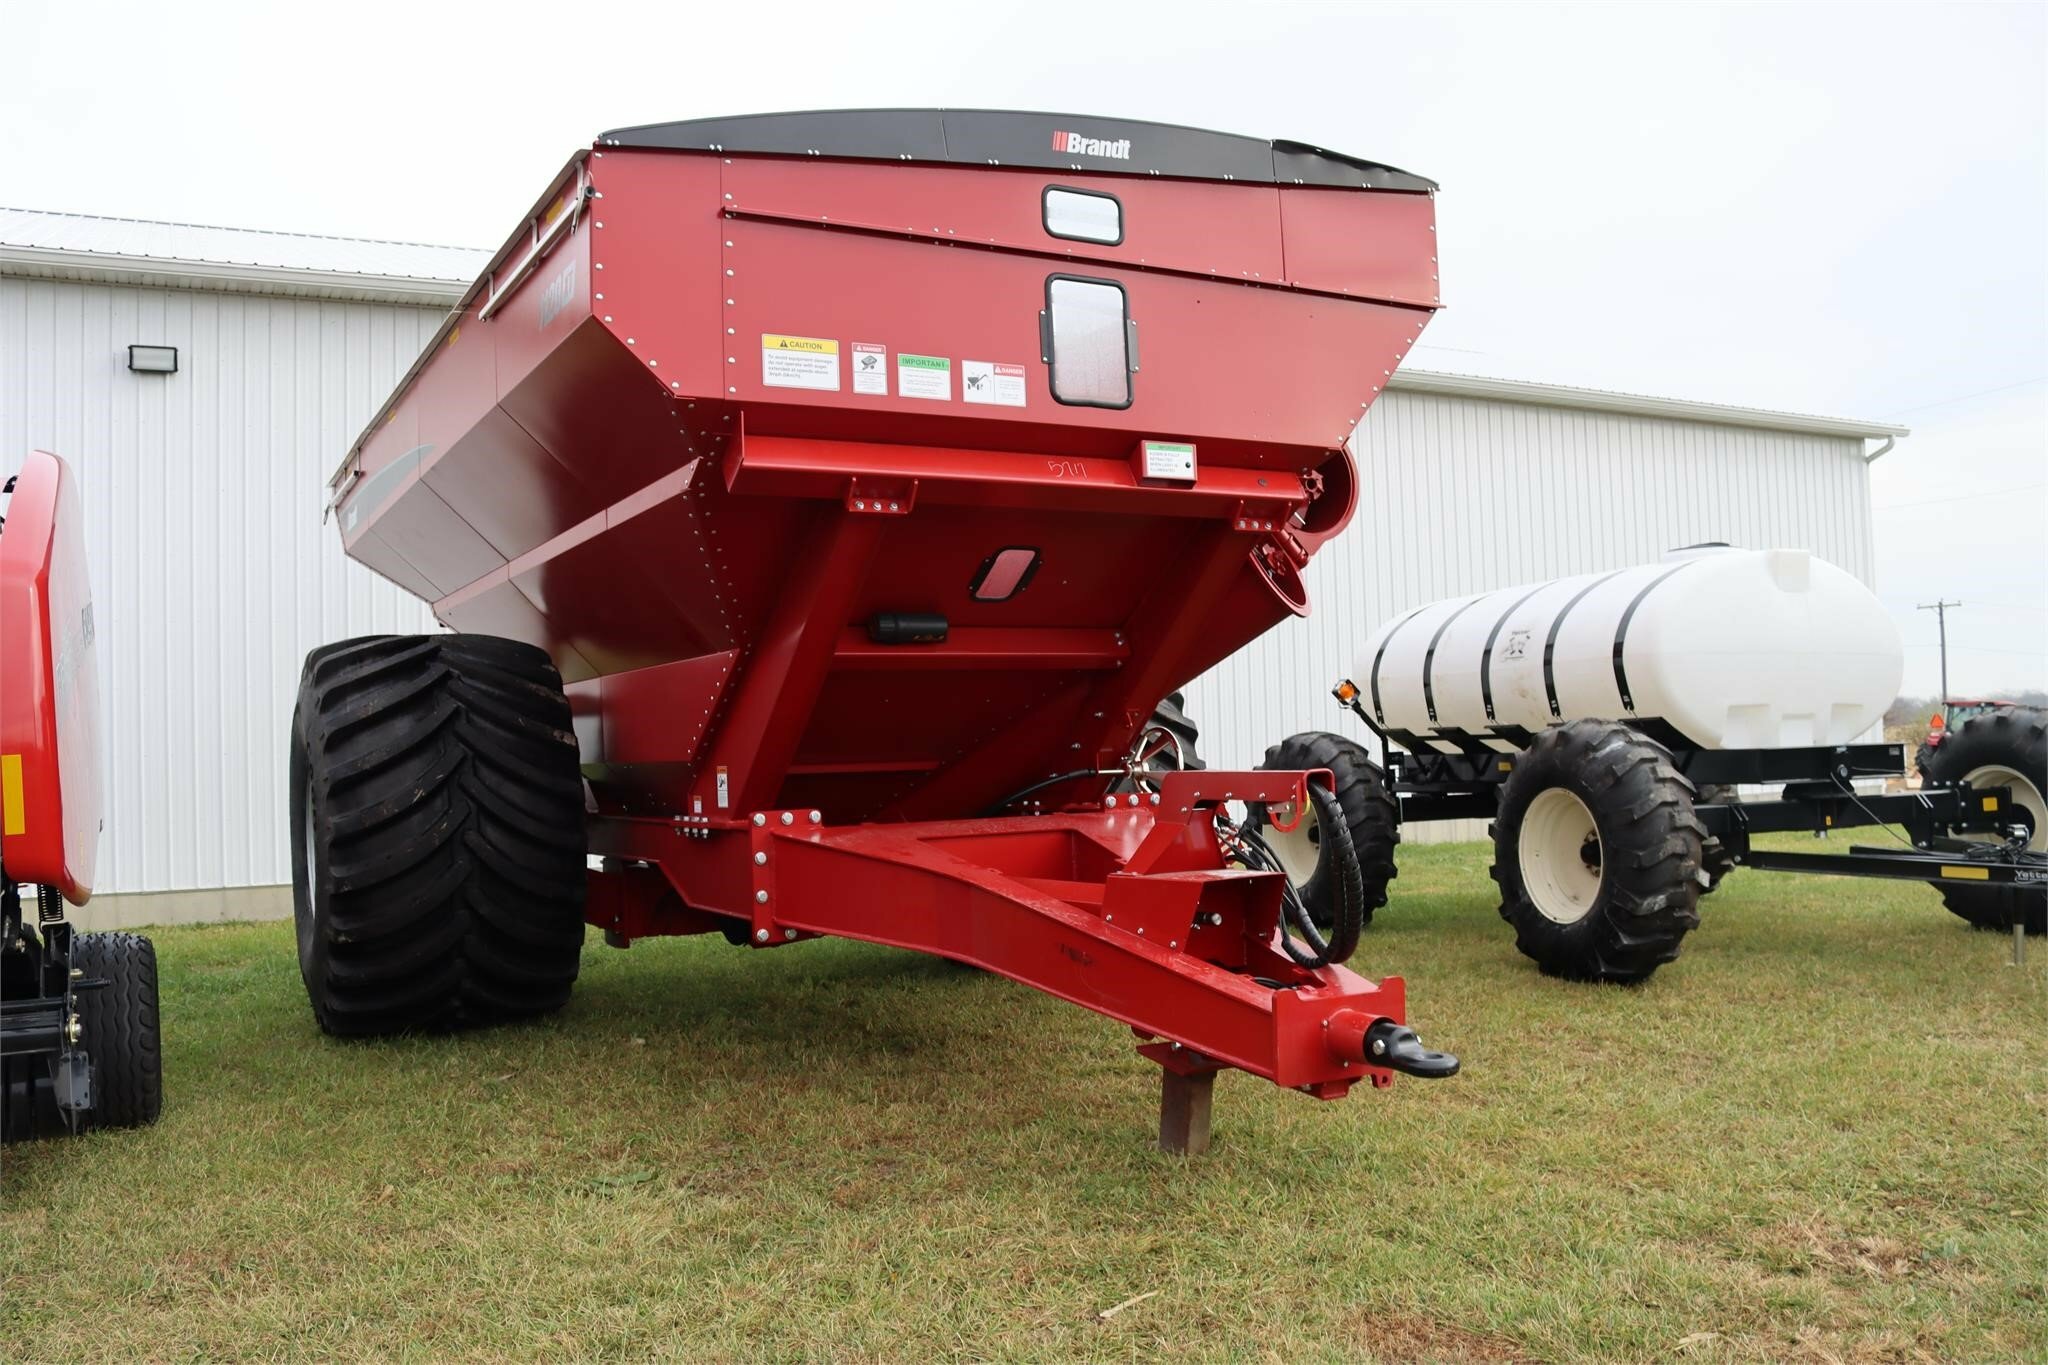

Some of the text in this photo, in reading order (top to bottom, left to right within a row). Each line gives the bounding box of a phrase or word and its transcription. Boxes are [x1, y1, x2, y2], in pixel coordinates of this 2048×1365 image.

[1067, 132, 1130, 159] Brandt
[789, 341, 823, 350] CAUTION
[902, 357, 945, 368] IMPORTANT
